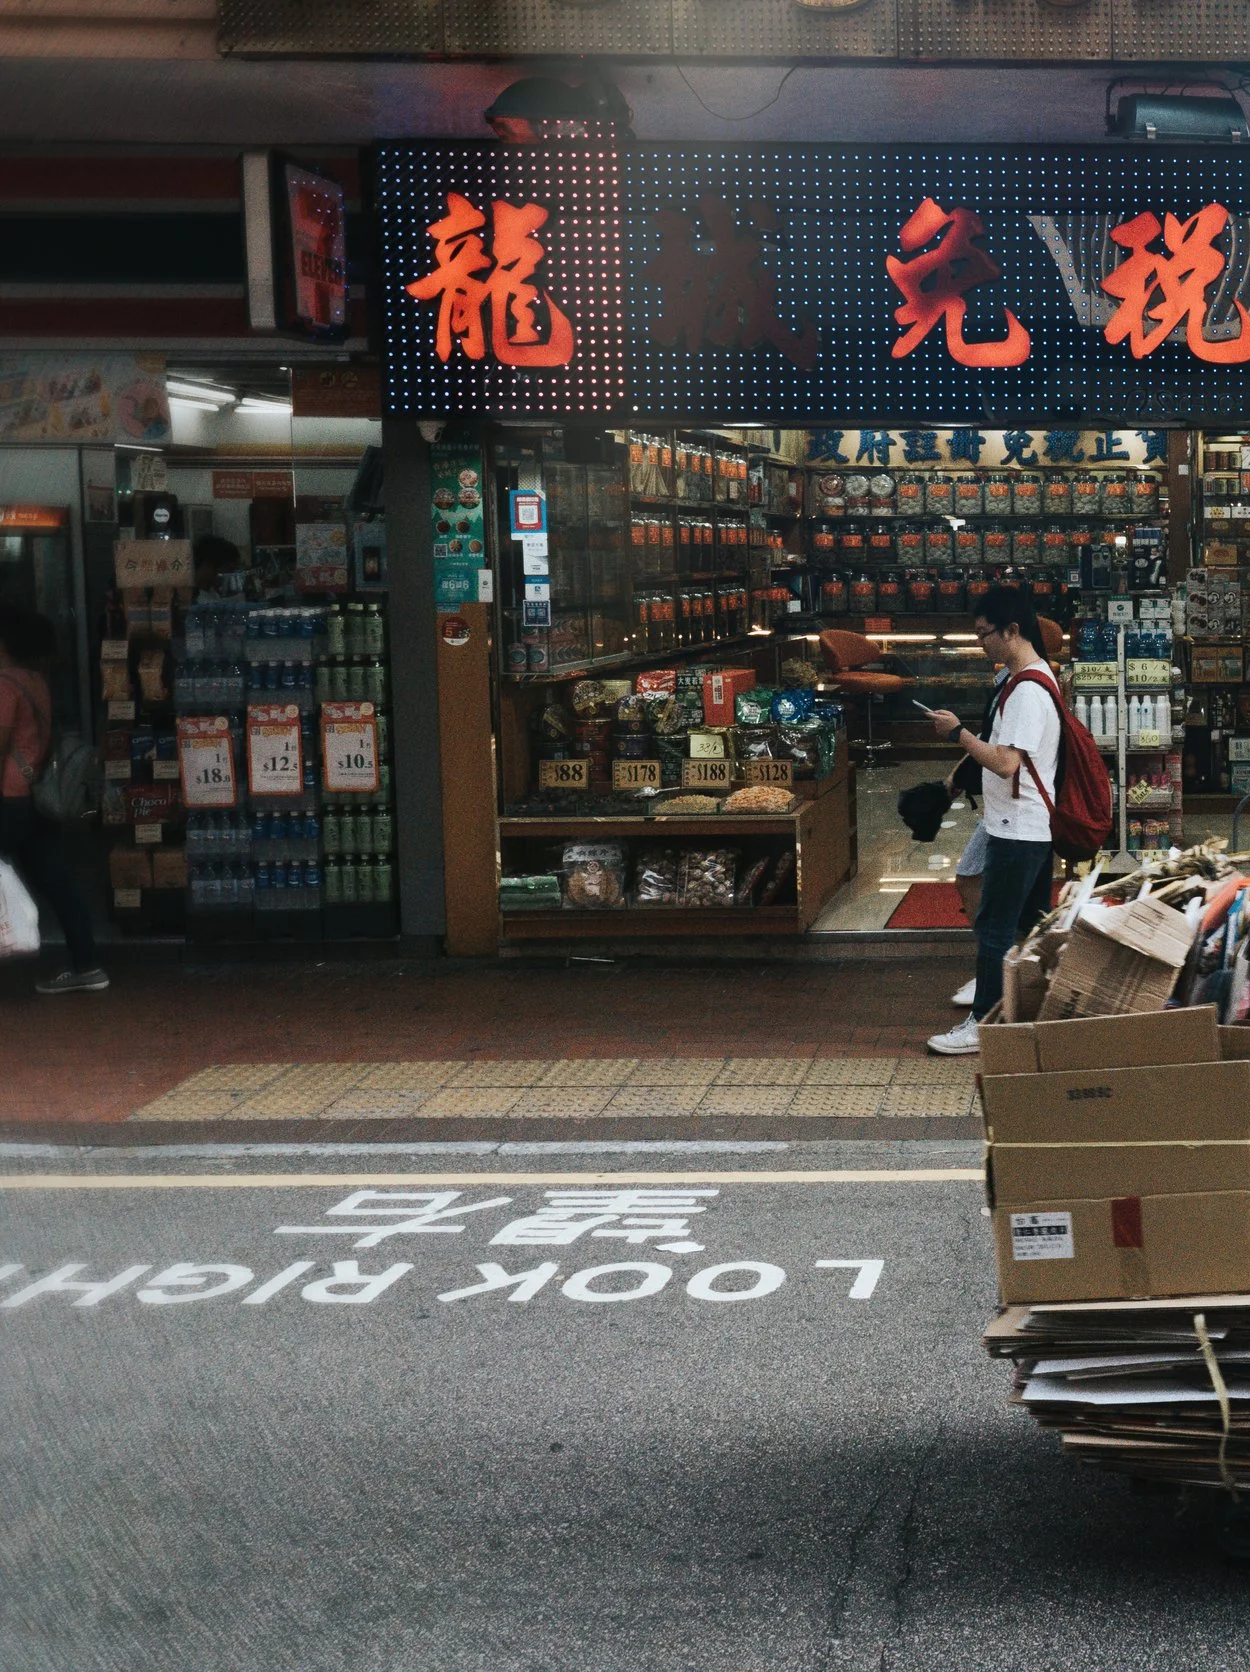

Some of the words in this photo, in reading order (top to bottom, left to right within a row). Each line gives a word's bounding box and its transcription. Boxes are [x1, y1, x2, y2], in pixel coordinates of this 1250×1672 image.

[627, 764, 656, 782] $178
[697, 763, 726, 781] $188
[759, 764, 788, 781] $128
[273, 1189, 719, 1252] 望右
[0, 1260, 414, 1308] RIGH
[436, 1259, 885, 1303] LOOK
